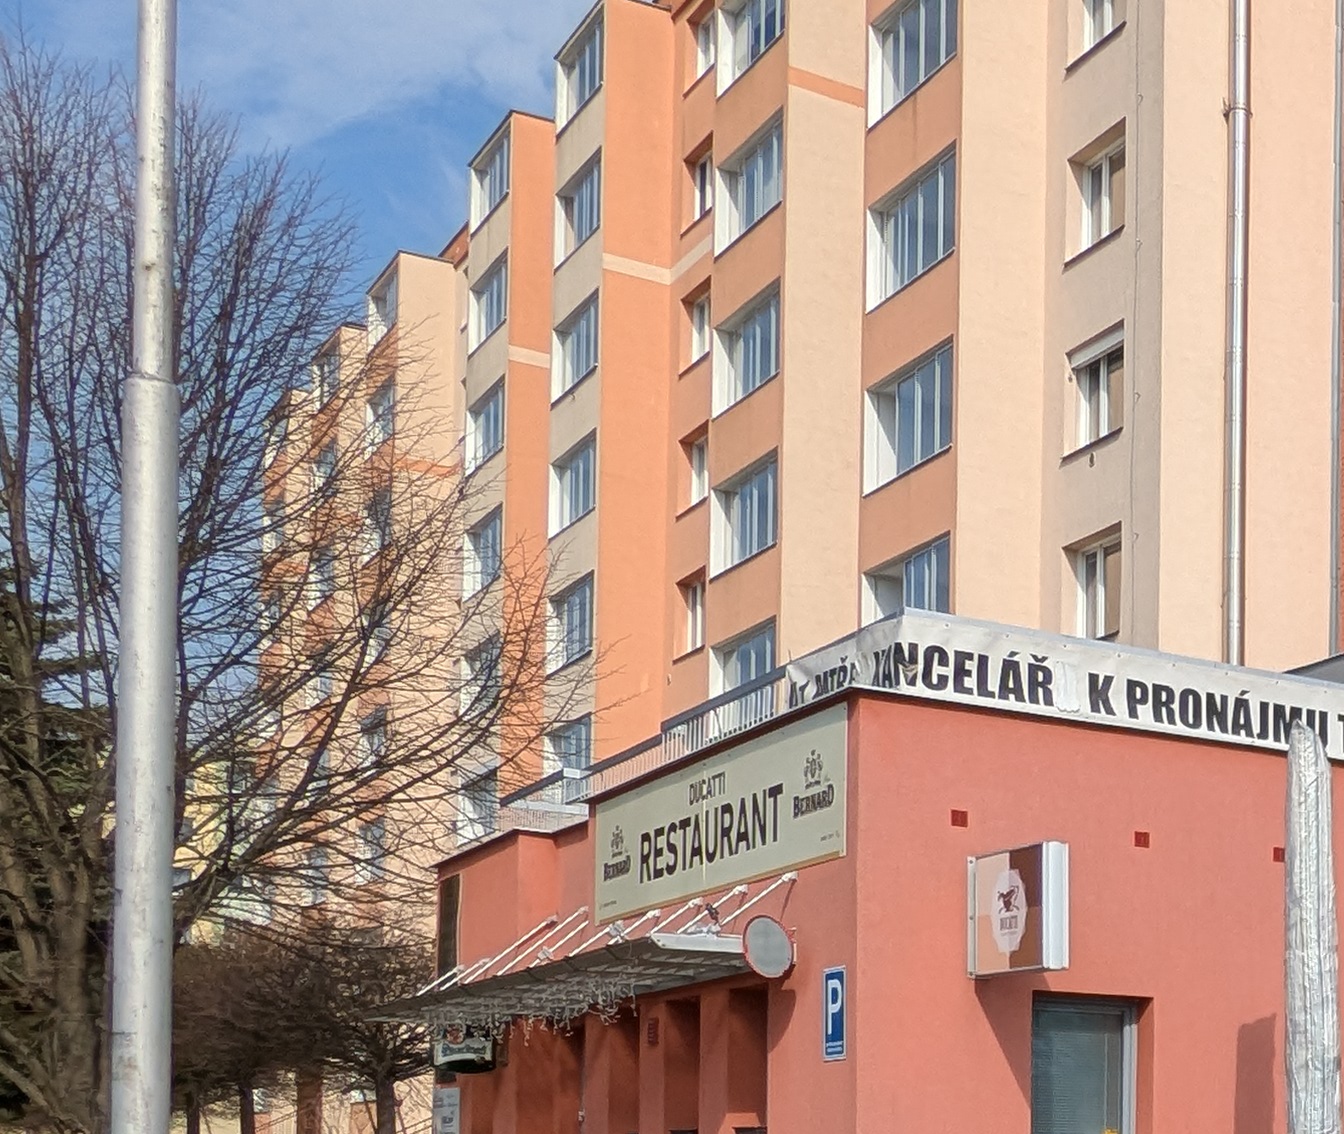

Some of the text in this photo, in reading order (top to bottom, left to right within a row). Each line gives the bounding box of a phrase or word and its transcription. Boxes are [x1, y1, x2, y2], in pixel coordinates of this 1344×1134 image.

[1088, 672, 1116, 717] K
[688, 771, 726, 806] DUCATTI
[792, 783, 835, 819] BERNARD
[639, 782, 784, 884] RESTAURANT
[827, 978, 843, 1035] P
